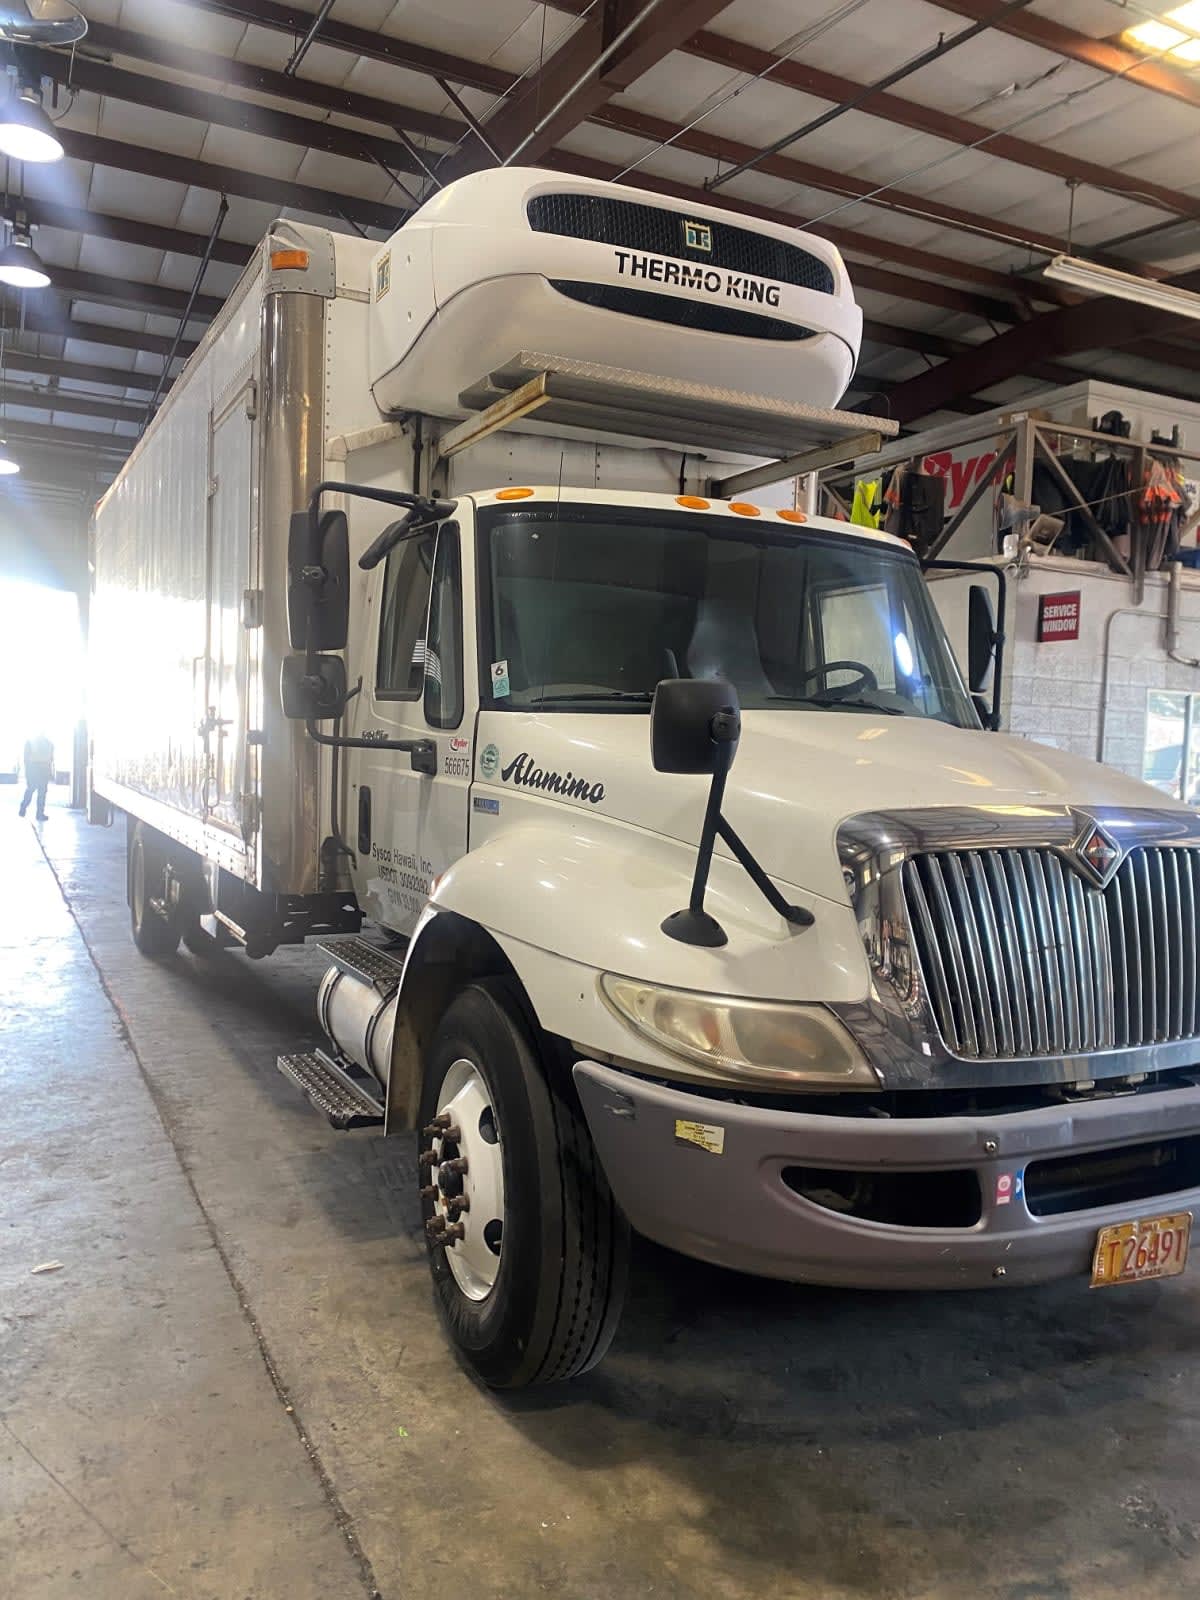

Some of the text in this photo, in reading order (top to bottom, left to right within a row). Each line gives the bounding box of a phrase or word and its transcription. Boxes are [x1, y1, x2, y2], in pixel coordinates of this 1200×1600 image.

[614, 251, 781, 307] THERMO KING
[1043, 603, 1077, 619] SERVICE
[1042, 618, 1077, 633] WINDOW
[495, 665, 504, 676] 6
[444, 756, 470, 777] 566675
[501, 752, 606, 804] Alamimo
[372, 842, 391, 862] Sysco
[420, 855, 434, 876] Inc.
